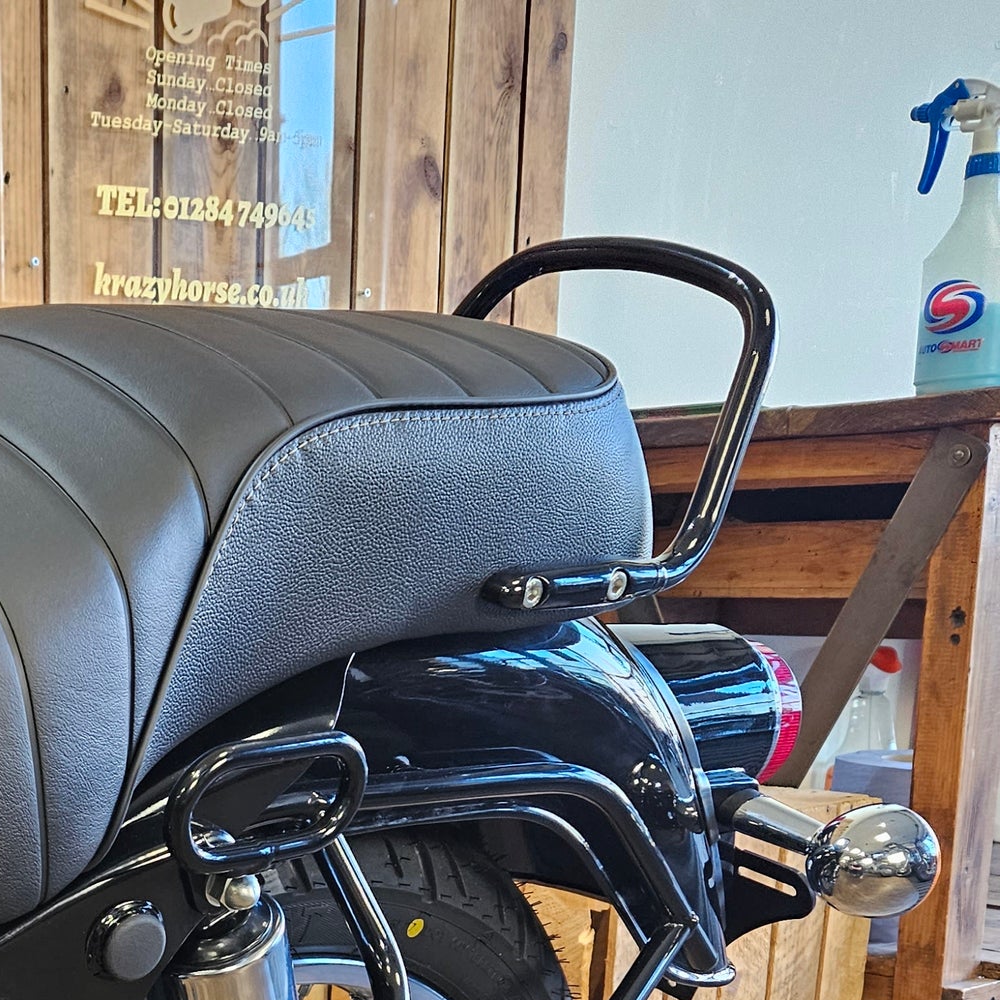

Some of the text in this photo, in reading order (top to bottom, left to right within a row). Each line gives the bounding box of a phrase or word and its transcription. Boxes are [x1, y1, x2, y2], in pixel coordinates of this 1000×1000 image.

[145, 46, 271, 75] Opening Times
[94, 261, 308, 308] krazyhorse.co.uk
